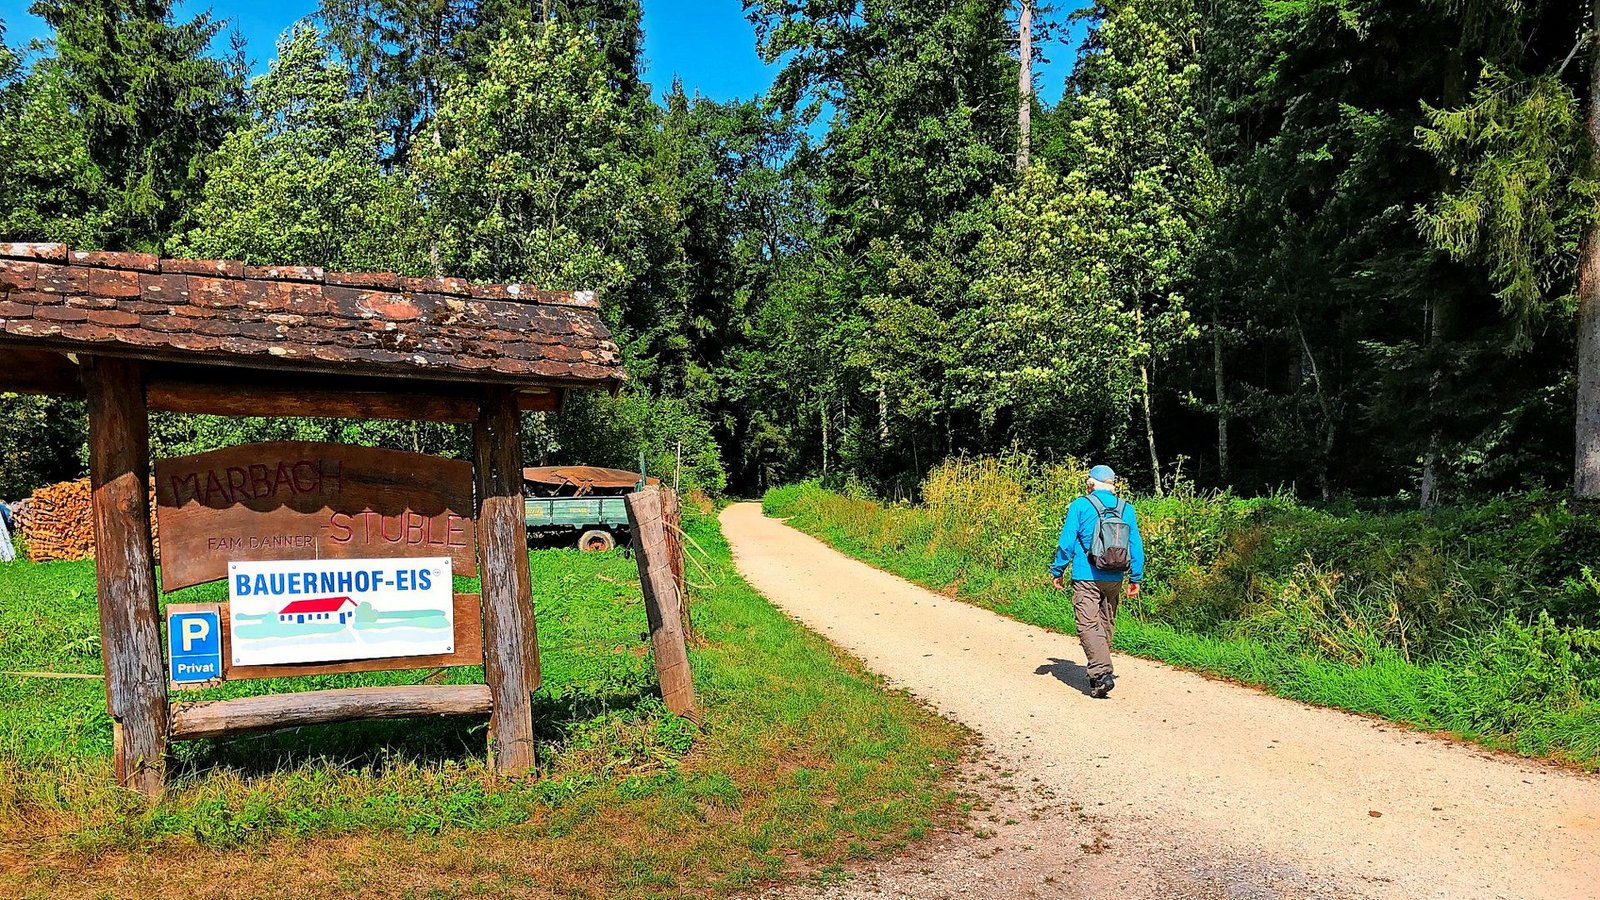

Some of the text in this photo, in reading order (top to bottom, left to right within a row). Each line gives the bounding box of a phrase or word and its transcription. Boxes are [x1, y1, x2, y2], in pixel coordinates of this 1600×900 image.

[171, 460, 343, 509] MARBACH
[250, 535, 313, 549] DANNER
[235, 568, 432, 596] BAUERNHOF-EIS
[182, 617, 210, 651] P
[177, 662, 214, 674] Privat
